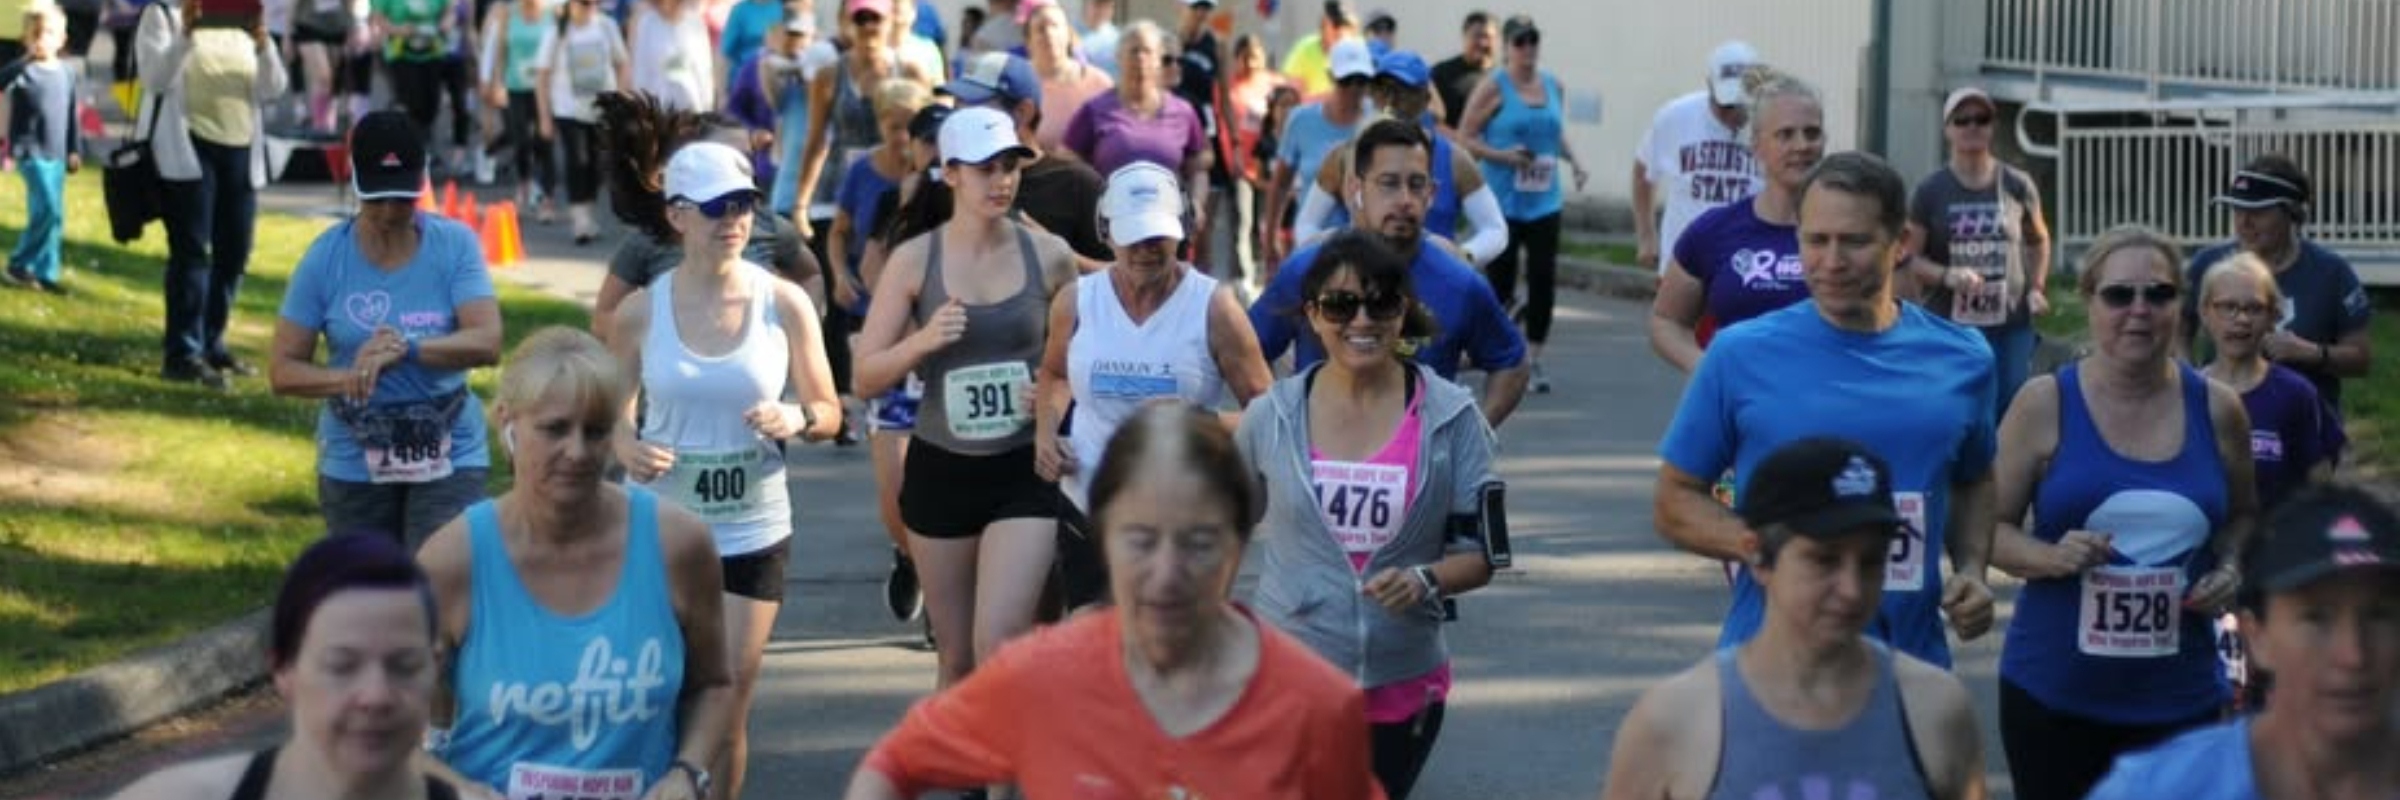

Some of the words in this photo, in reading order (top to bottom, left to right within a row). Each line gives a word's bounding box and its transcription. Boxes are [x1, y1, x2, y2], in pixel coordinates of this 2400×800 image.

[965, 382, 1016, 420] 391
[694, 466, 745, 503] 400
[2092, 590, 2171, 632] 1528
[488, 635, 665, 751] refit
